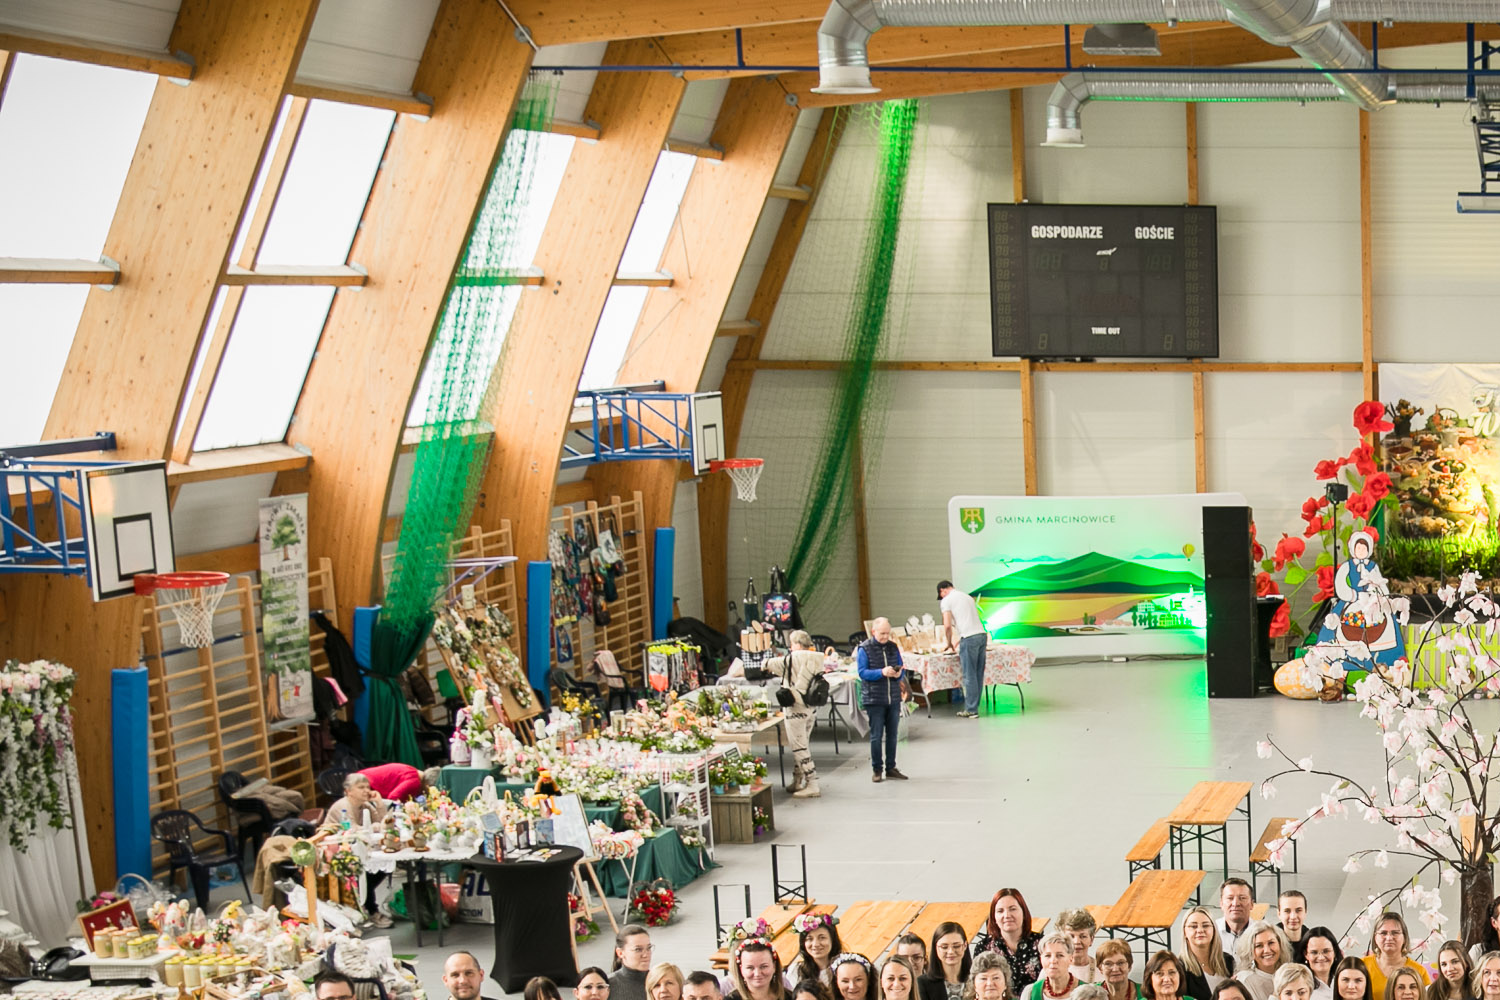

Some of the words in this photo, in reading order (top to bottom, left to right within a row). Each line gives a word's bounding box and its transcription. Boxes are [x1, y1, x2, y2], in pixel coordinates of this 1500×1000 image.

[1031, 225, 1103, 239] GOSPODARZE
[1134, 225, 1175, 240] GOŚCIE
[1091, 327, 1107, 335] TIME
[1108, 327, 1121, 335] OUT
[995, 516, 1033, 524] GMINA
[1036, 515, 1116, 524] MARCINOWICE
